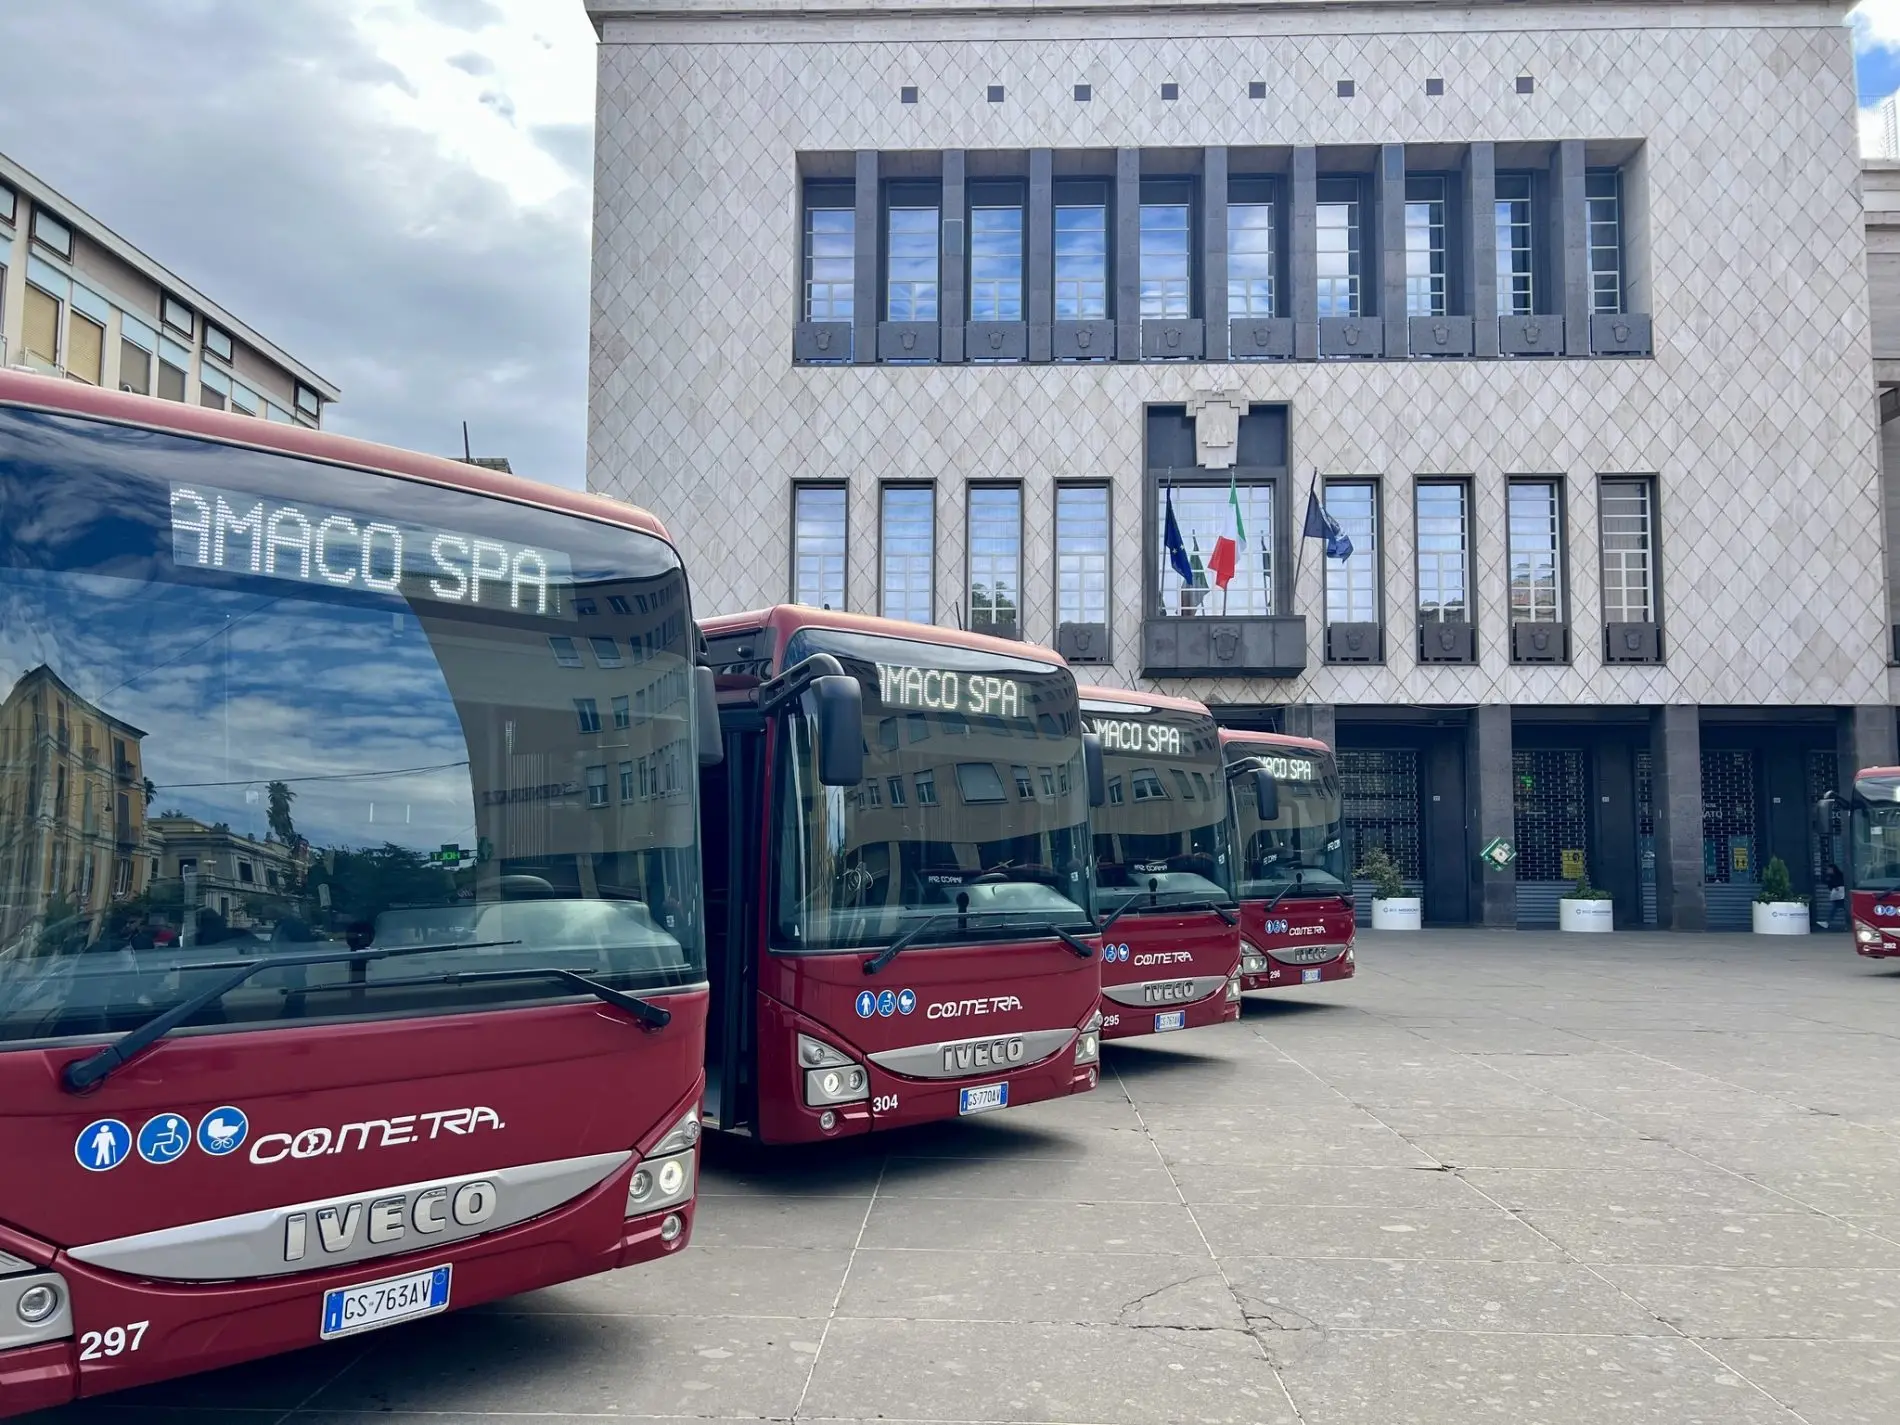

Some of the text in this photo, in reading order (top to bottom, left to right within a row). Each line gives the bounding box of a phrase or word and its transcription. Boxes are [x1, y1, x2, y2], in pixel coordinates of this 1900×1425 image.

[171, 488, 547, 615] AMACO SPA
[968, 675, 1017, 717] SPA
[1147, 725, 1180, 754] SPA
[1290, 759, 1311, 780] SPA
[1144, 980, 1194, 1002] IVECO
[1103, 1015, 1120, 1027] 295
[943, 1037, 1024, 1072] IVECO
[873, 1094, 898, 1112] 304
[284, 1180, 497, 1262] IVECO
[79, 1320, 149, 1361] 297
